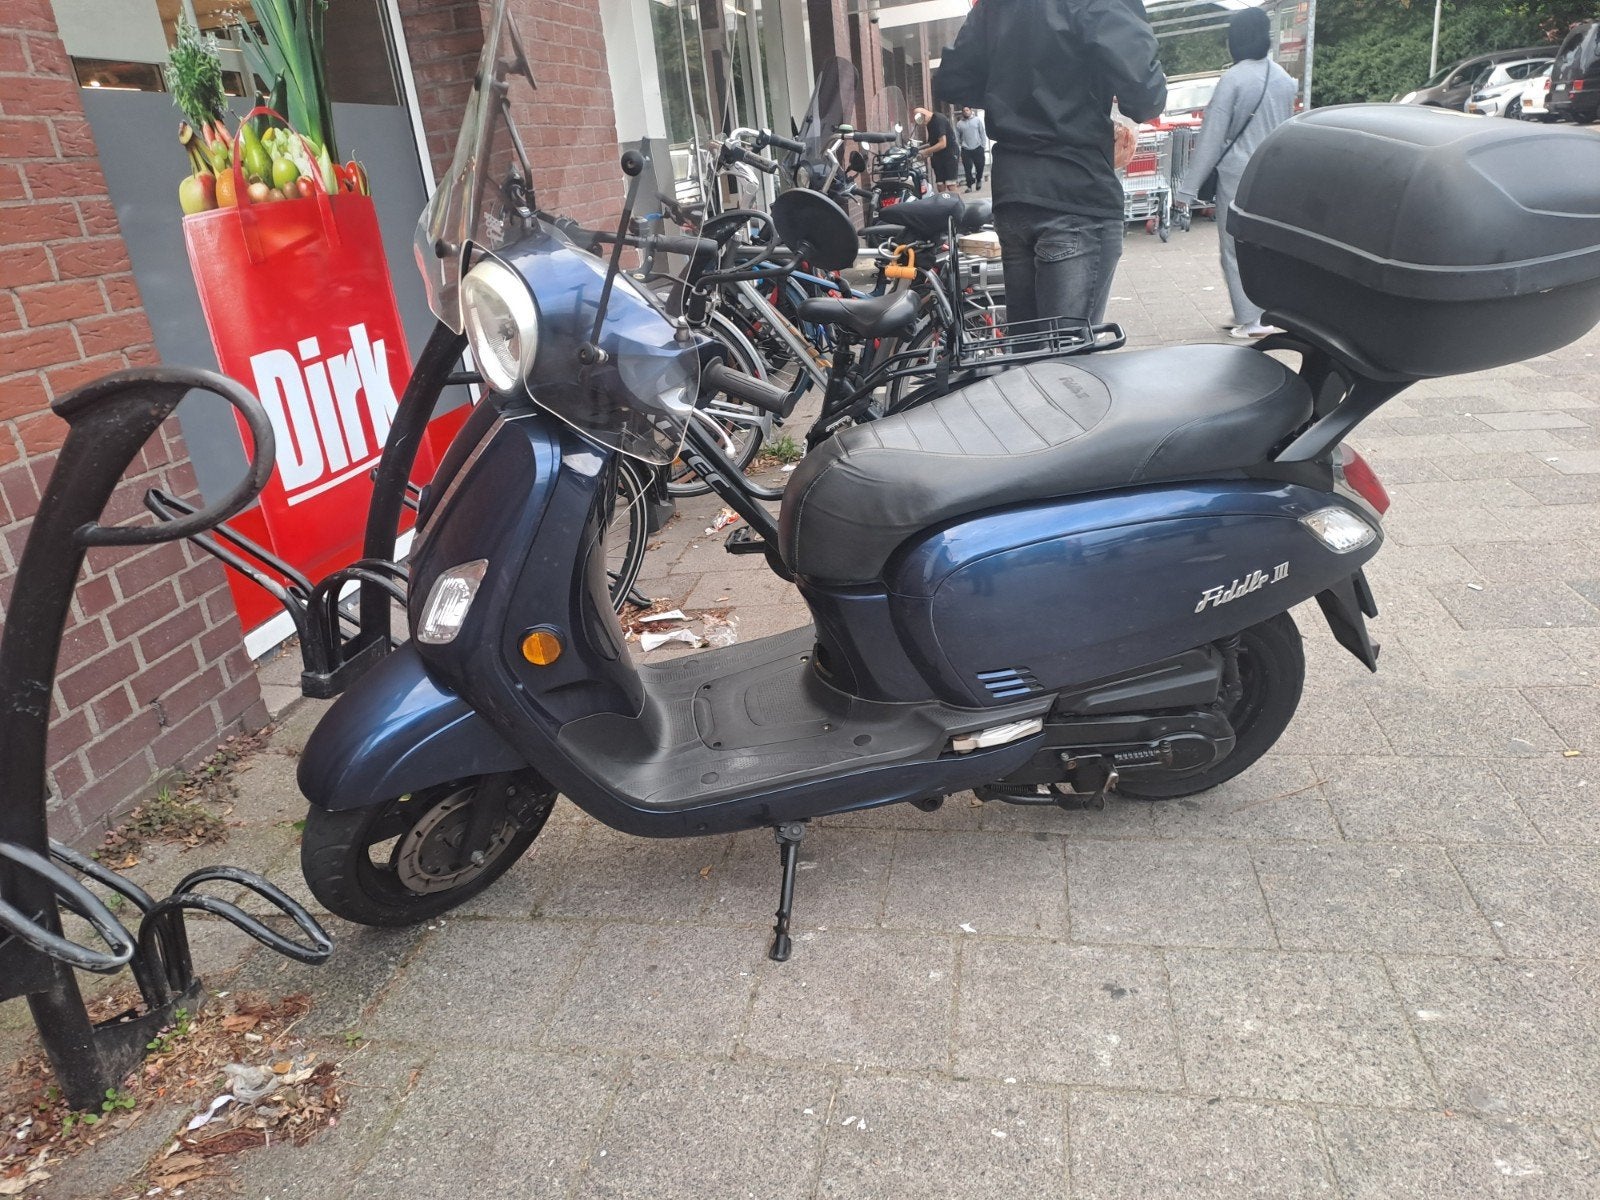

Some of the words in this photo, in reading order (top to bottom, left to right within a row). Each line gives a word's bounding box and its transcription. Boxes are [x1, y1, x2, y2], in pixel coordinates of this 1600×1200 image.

[250, 322, 399, 492] Dirk
[1194, 569, 1270, 613] Fiddle
[1270, 561, 1290, 584] III
